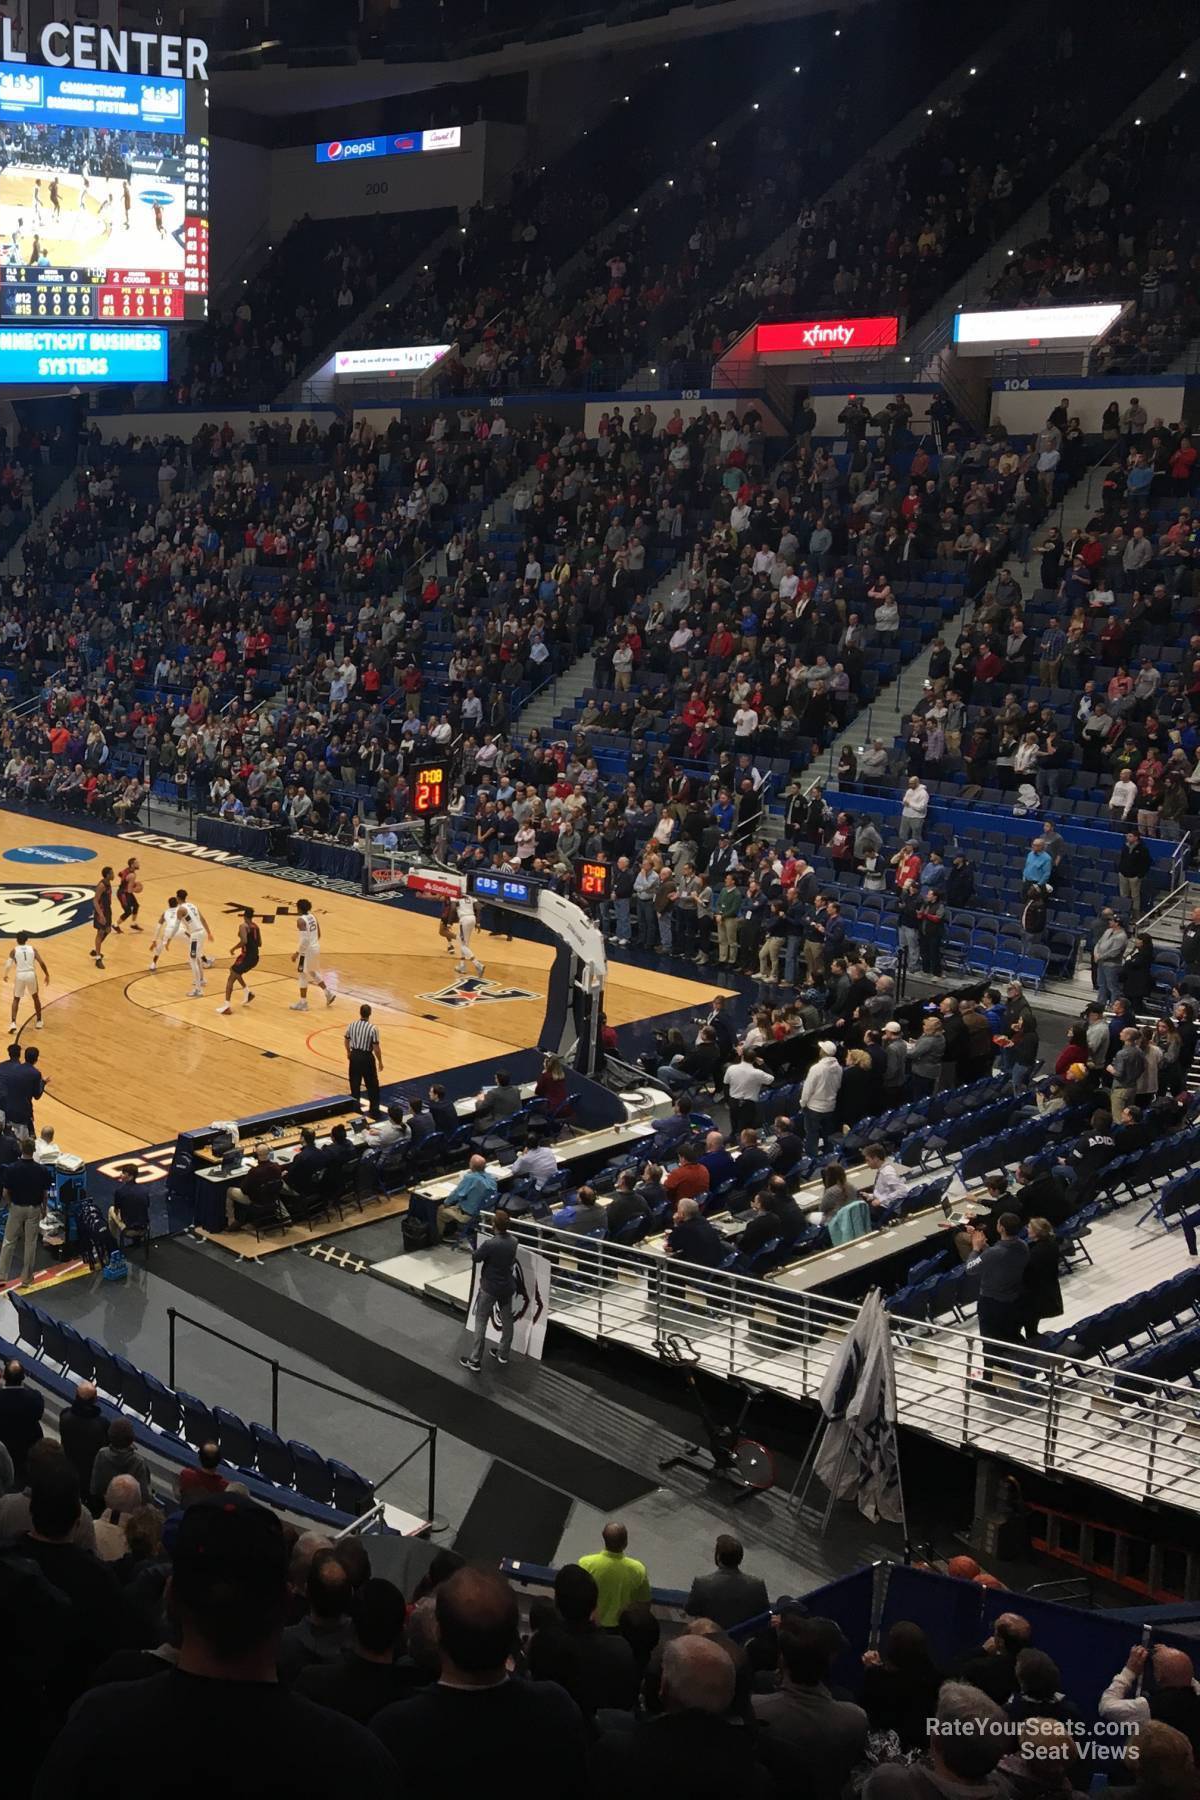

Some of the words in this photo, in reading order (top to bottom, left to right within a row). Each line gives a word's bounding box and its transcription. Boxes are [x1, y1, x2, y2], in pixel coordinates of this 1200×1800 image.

[40, 21, 209, 81] CENTER
[59, 81, 127, 98] CONNECTICUT
[47, 96, 94, 112] BUSINESS
[95, 100, 139, 116] SYSTEMS
[344, 141, 375, 157] pepsi
[7, 161, 70, 174] UCONN
[366, 182, 389, 195] 200
[70, 270, 78, 282] 0
[113, 272, 120, 283] 2
[90, 334, 162, 352] BUSINESS
[803, 324, 855, 346] xfinity
[38, 357, 109, 376] SYSTEMS
[1003, 378, 1030, 391] 104
[489, 397, 504, 407] 102
[681, 390, 701, 401] 103
[419, 768, 443, 785] 17:08
[417, 785, 441, 809] 21
[118, 830, 243, 865] UCONN
[583, 863, 606, 879] 17:08
[476, 877, 498, 890] CBS
[503, 882, 526, 895] CBS
[582, 877, 603, 893] 21
[23, 951, 28, 961] 1
[1088, 1135, 1115, 1147] ADID
